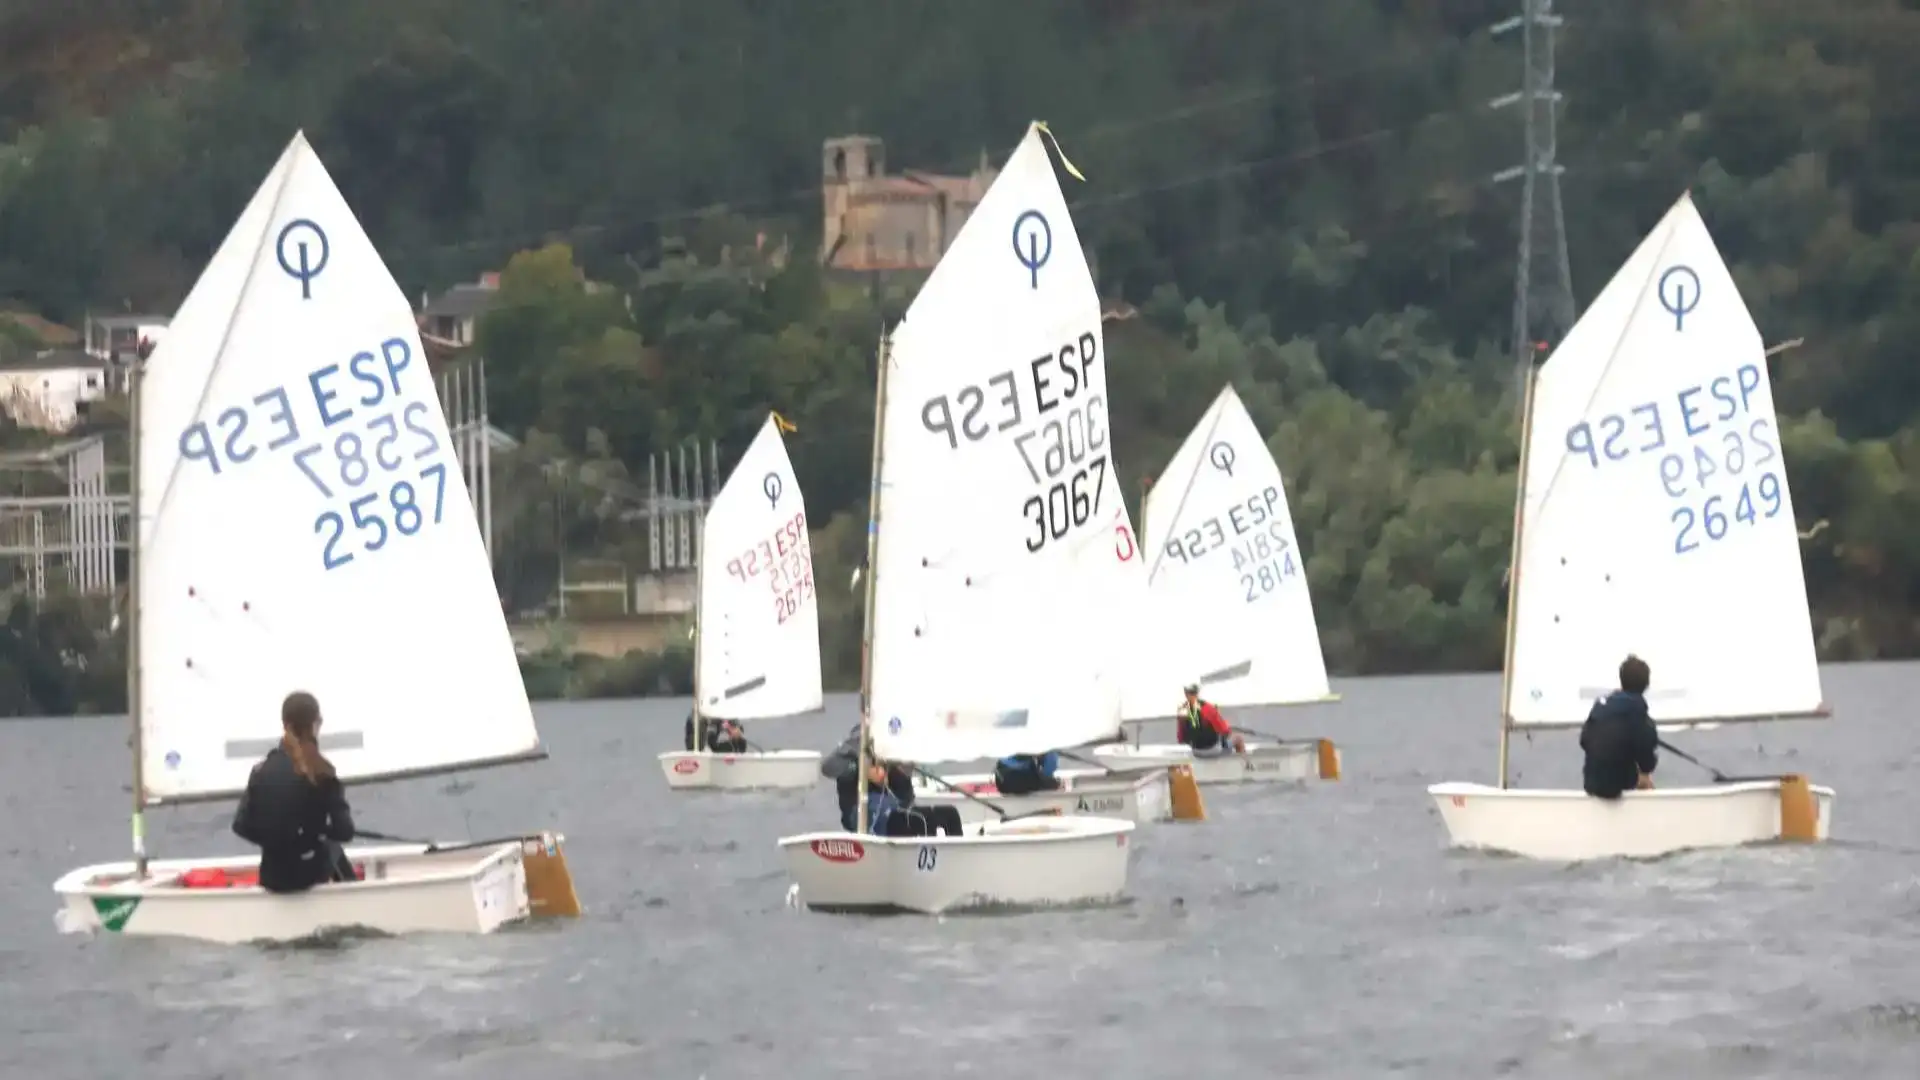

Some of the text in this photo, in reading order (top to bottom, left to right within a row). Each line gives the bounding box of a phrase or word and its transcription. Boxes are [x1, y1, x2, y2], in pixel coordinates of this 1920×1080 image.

[308, 337, 411, 427] ESP
[1031, 331, 1096, 414] ESP
[1677, 364, 1760, 436] ESP
[314, 462, 446, 571] 2587
[775, 512, 804, 557] ESP
[1023, 455, 1107, 553] 3067
[1228, 486, 1278, 535] ESP
[1671, 472, 1781, 554] 2649
[1240, 551, 1296, 603] 2814
[917, 844, 937, 871] 03
